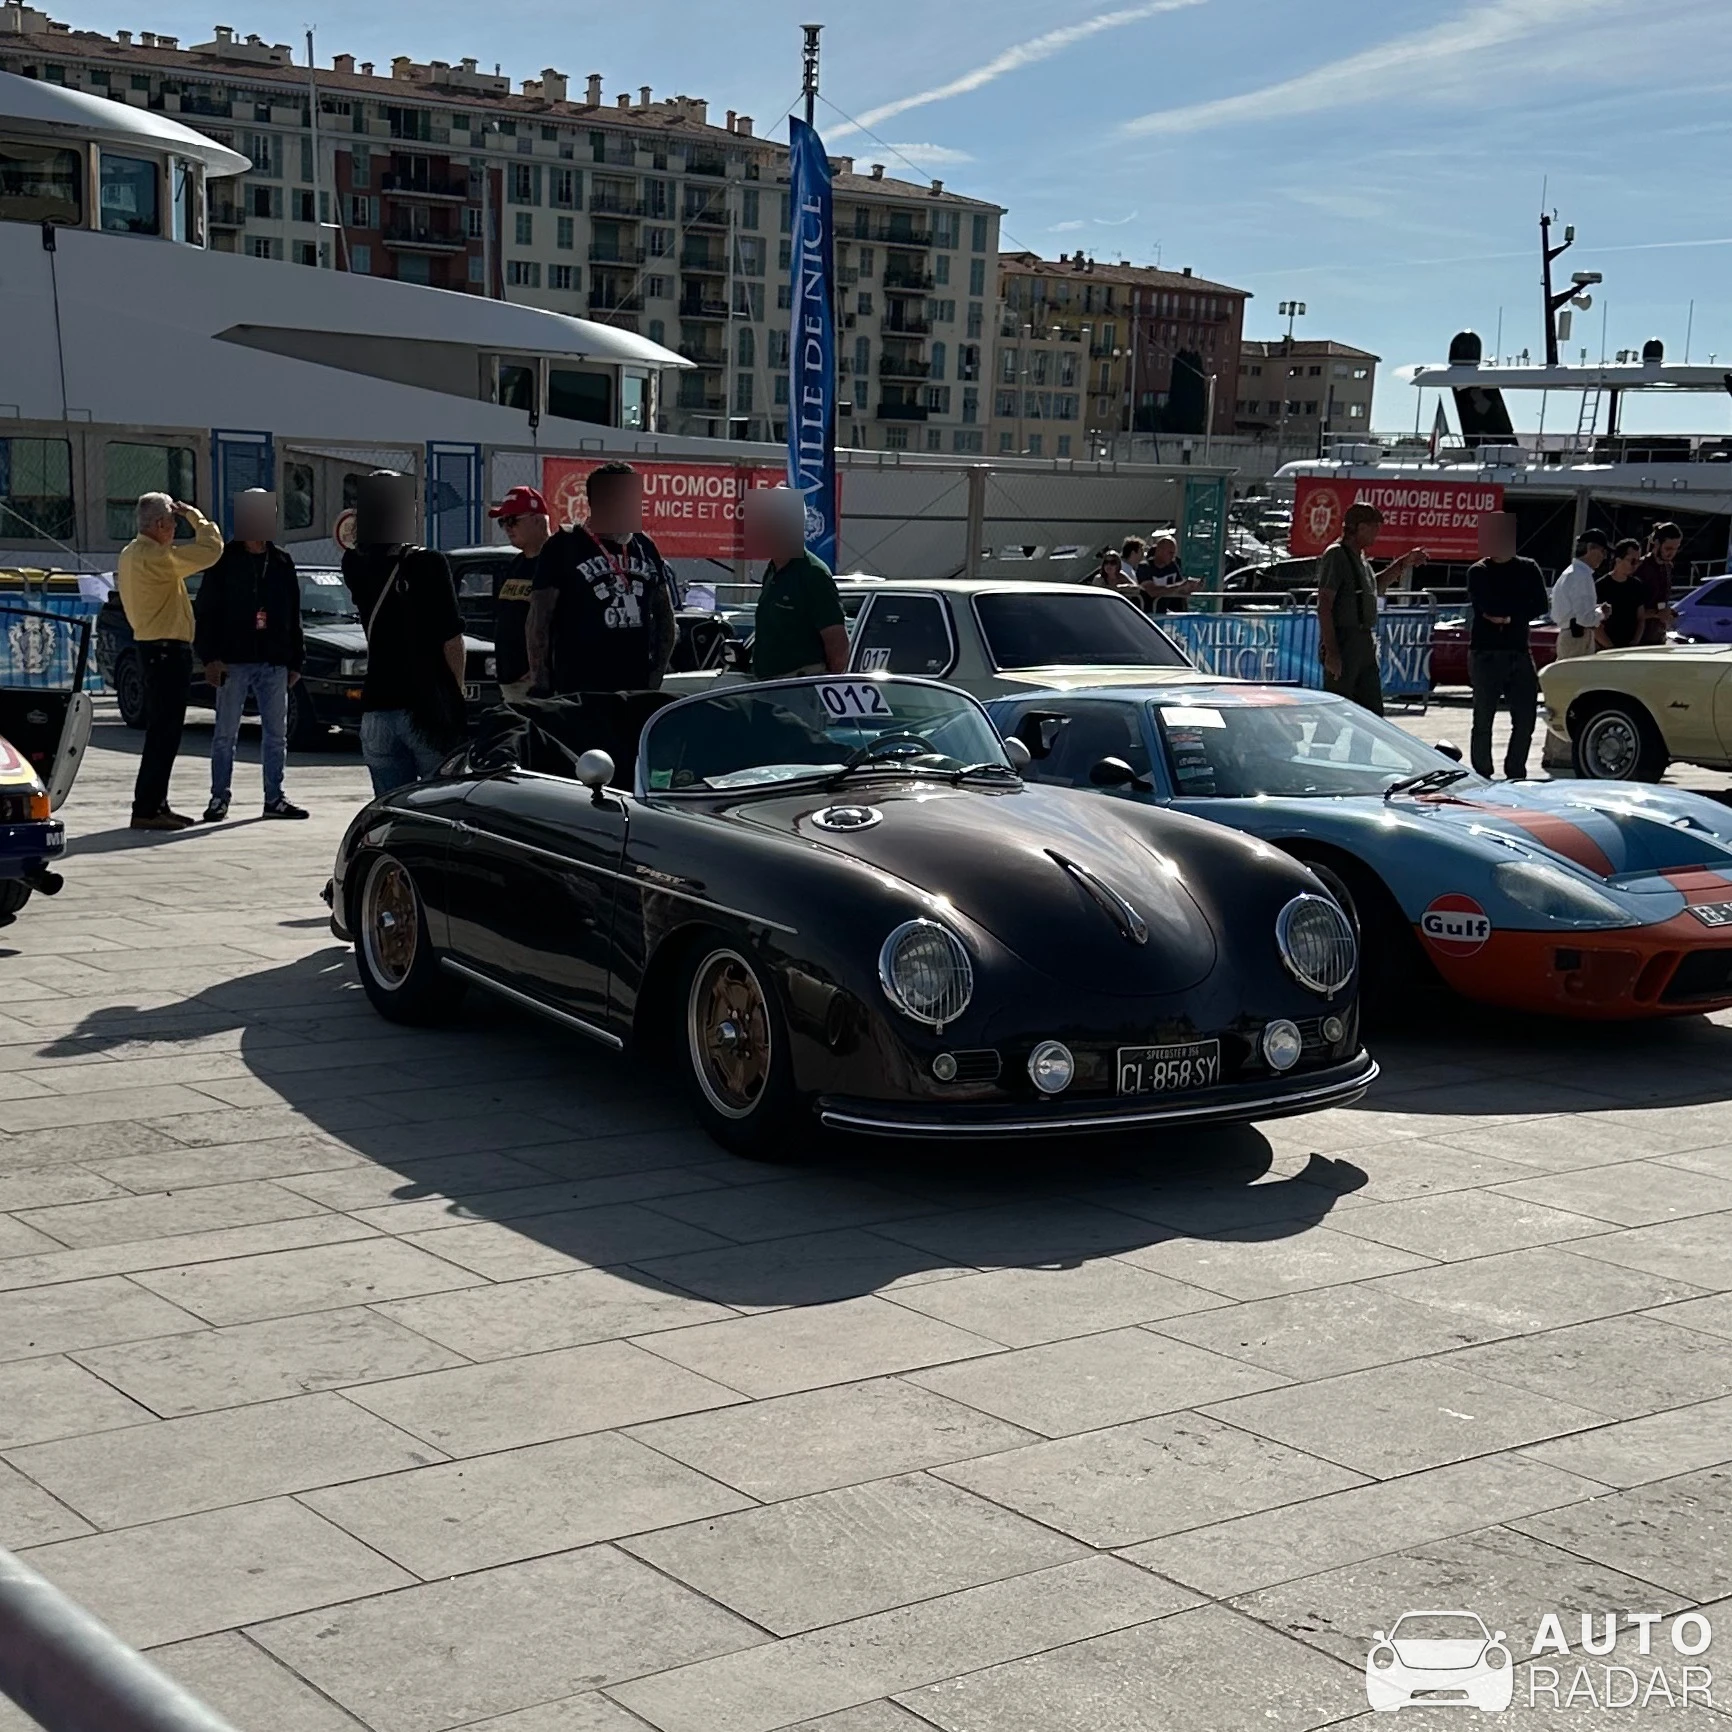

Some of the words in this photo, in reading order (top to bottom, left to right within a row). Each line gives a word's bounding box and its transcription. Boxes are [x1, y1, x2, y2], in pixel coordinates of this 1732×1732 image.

[802, 195, 823, 303] NICE
[805, 313, 823, 374] DE
[800, 386, 824, 495] VILLE
[643, 474, 768, 499] UTOMOBI
[642, 501, 650, 516] E
[655, 501, 693, 518] NICE
[698, 503, 719, 519] ET
[722, 500, 745, 520] CÔ
[1354, 488, 1453, 510] AUTOMOBILE
[1456, 492, 1495, 511] CLUB
[1383, 511, 1397, 525] CE
[1400, 512, 1415, 526] ET
[1418, 510, 1450, 527] CÔTE
[1452, 514, 1478, 528] D'AZ
[1193, 622, 1246, 646] VILLE
[1252, 621, 1279, 646] DE
[863, 650, 888, 671] 017
[1195, 647, 1280, 682] NICE
[1384, 646, 1434, 684] NIC
[822, 685, 889, 715] 012
[1424, 915, 1487, 936] Gulf
[1146, 1047, 1186, 1060] SPEEDSTER
